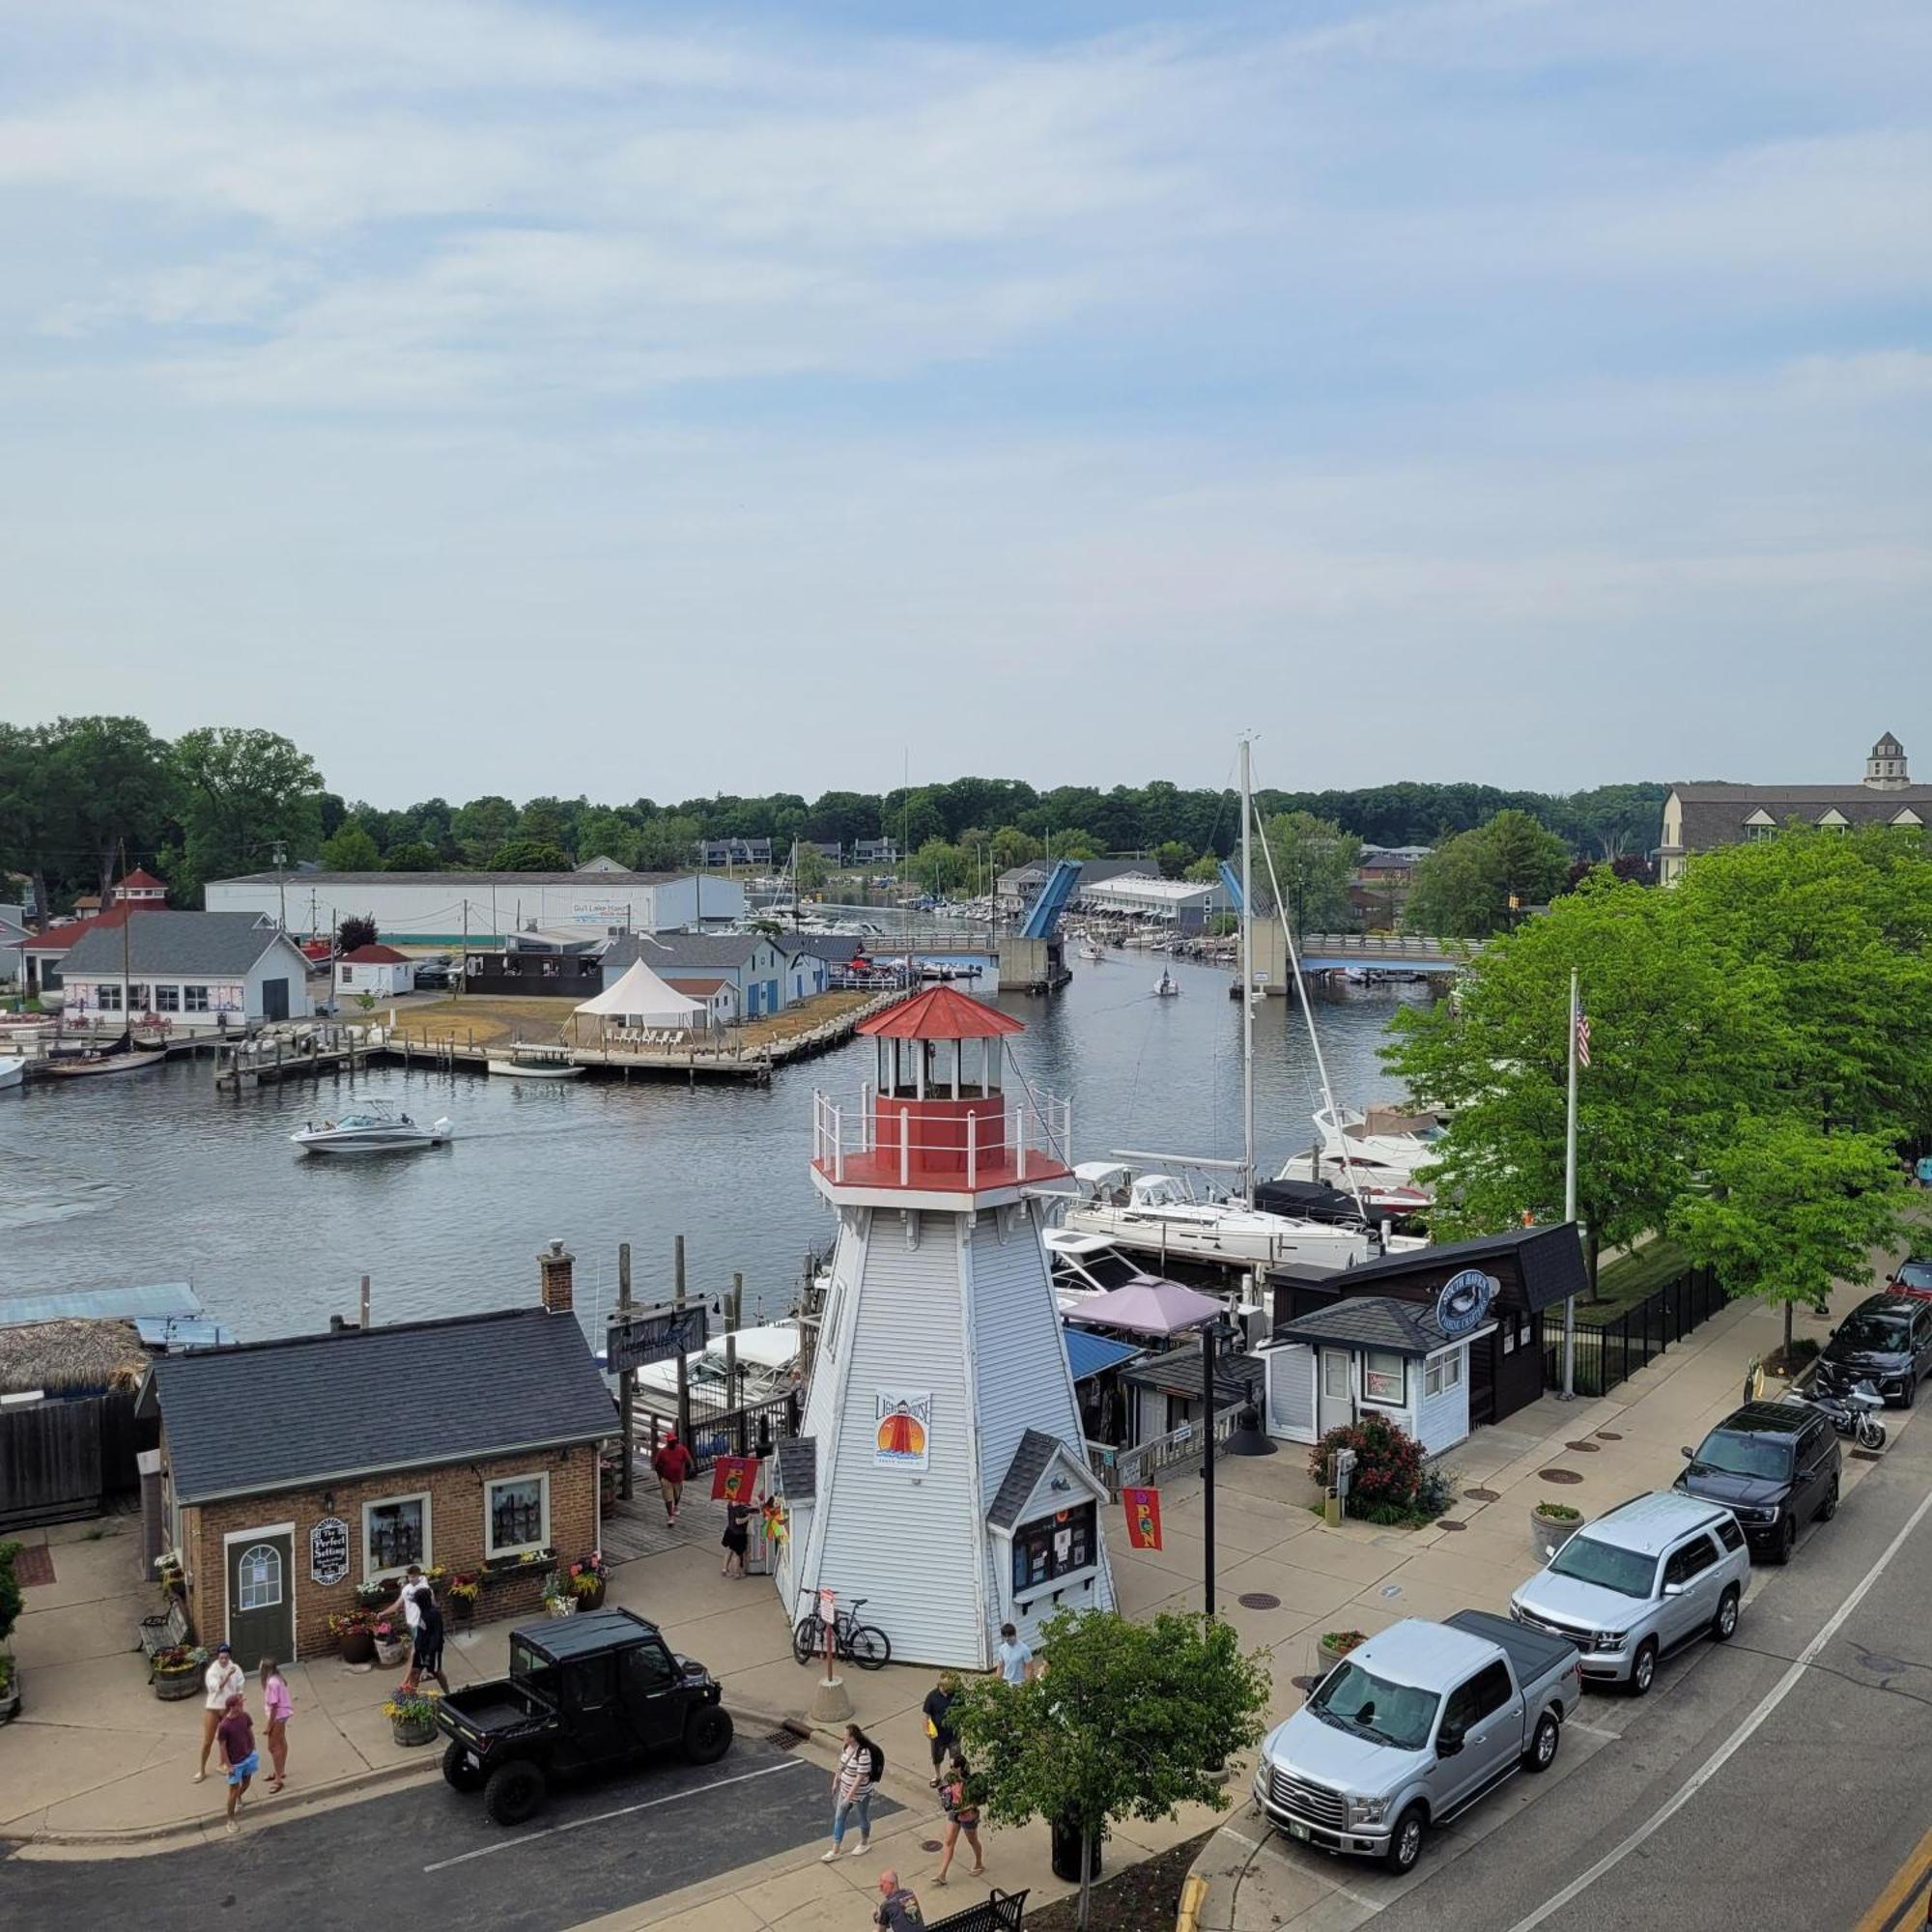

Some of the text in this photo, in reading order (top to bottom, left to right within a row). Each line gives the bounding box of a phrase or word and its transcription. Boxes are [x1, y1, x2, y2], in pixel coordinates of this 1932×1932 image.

[1443, 1273, 1488, 1306] SOUTH HAVEN
[314, 1535, 345, 1548] Perfect
[315, 1548, 345, 1560] Setting
